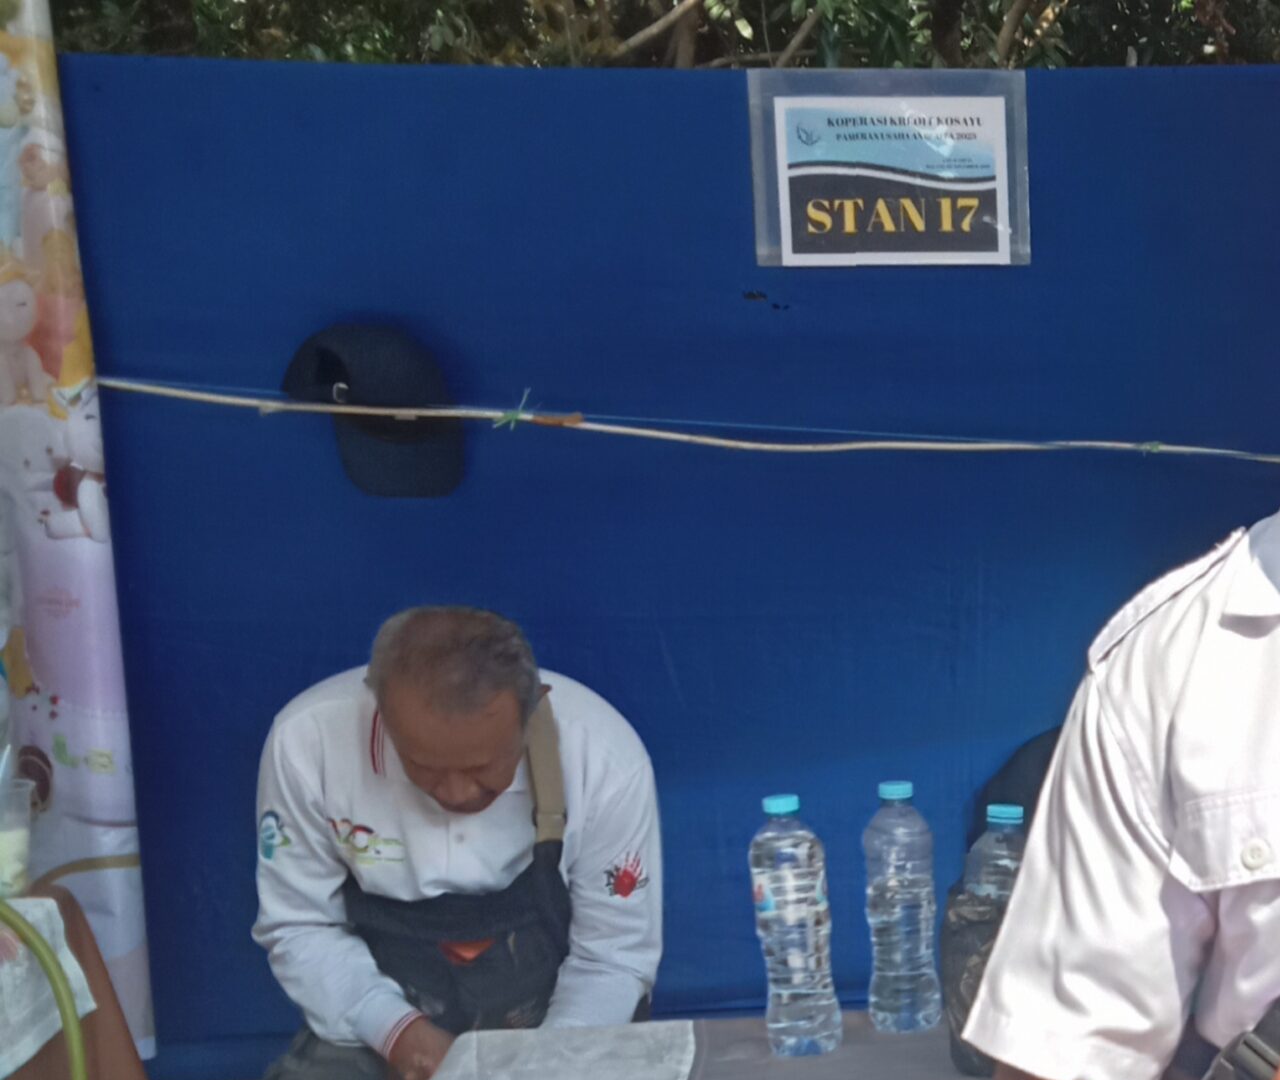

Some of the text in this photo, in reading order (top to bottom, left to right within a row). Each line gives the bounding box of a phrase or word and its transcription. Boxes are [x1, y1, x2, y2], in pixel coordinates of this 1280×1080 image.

[826, 115, 888, 128] KOPERASI
[935, 115, 984, 127] KOSAYU
[805, 196, 981, 235] STAN 17
